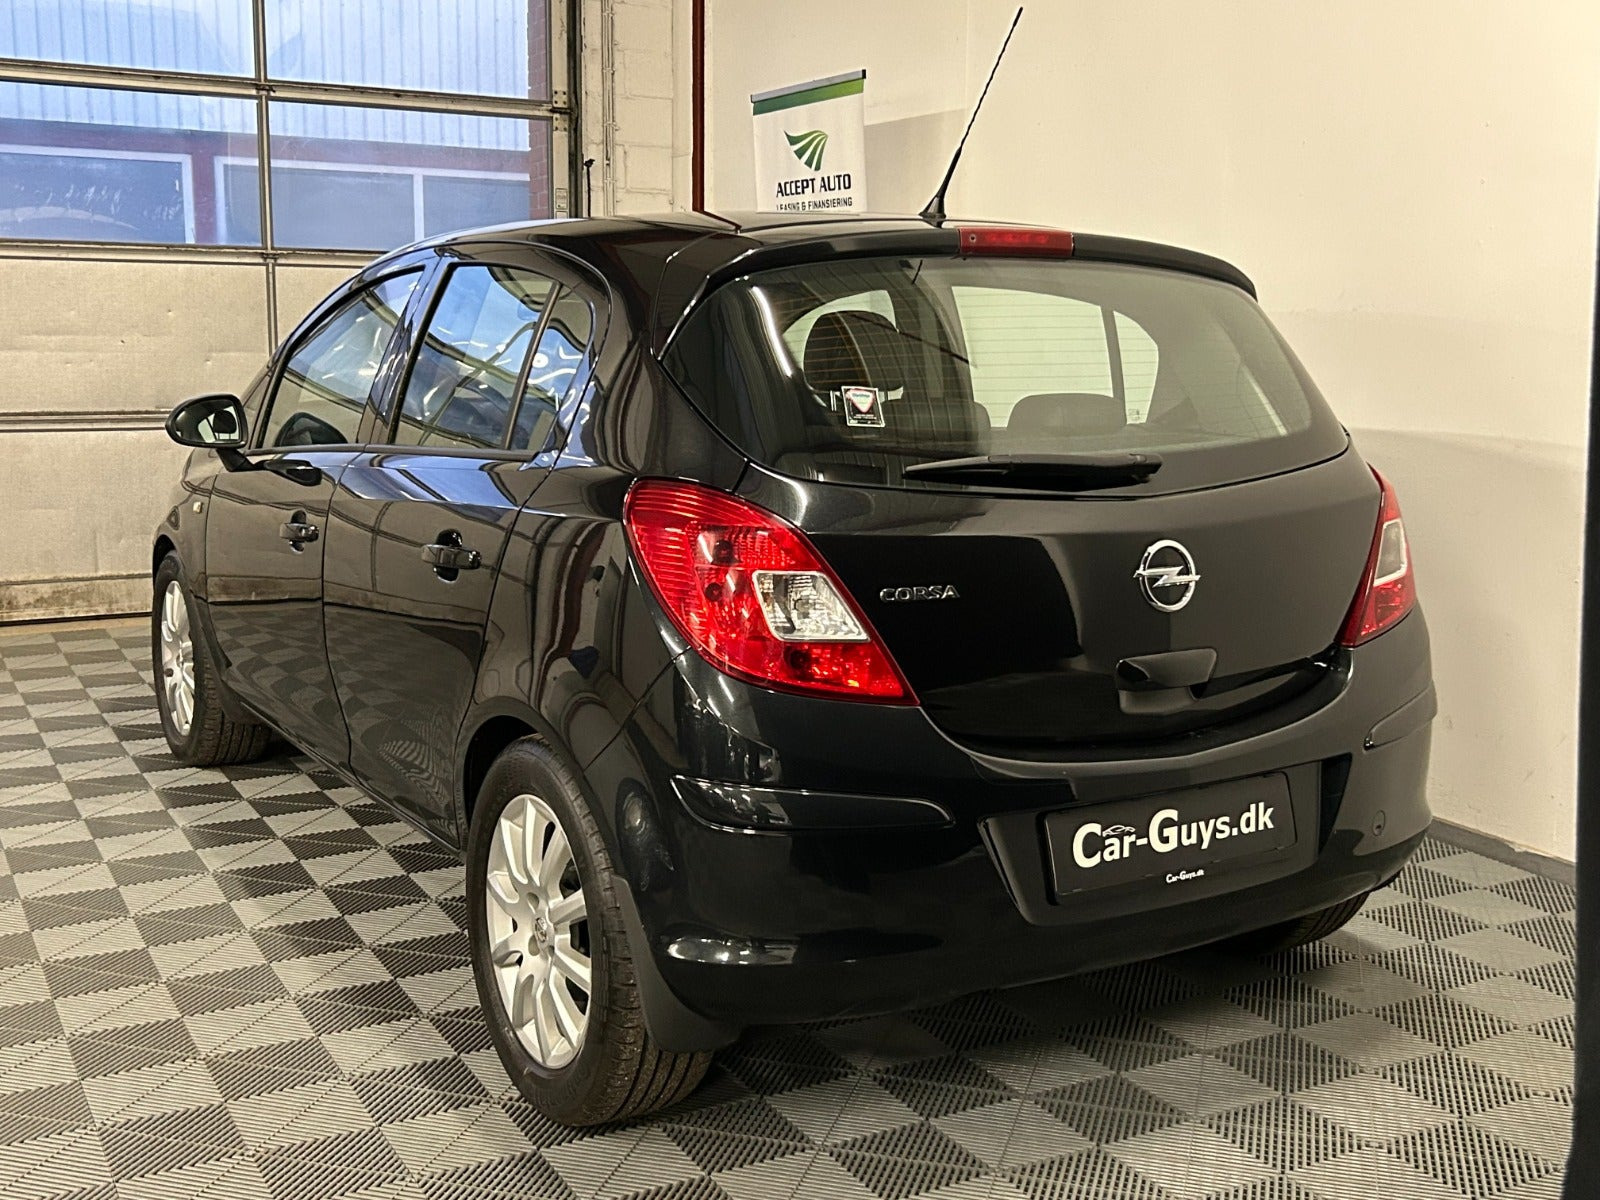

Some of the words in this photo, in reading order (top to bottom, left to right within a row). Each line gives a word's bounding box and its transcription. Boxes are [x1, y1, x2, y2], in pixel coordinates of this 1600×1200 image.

[776, 178, 816, 197] ACCEPT
[820, 173, 852, 193] AUTO
[801, 201, 806, 211] &
[808, 197, 853, 210] FINANSIERING
[879, 585, 960, 601] CORSA
[1072, 802, 1274, 868] Car-Guys.dk
[1166, 869, 1204, 883] Car-Guys.dk
